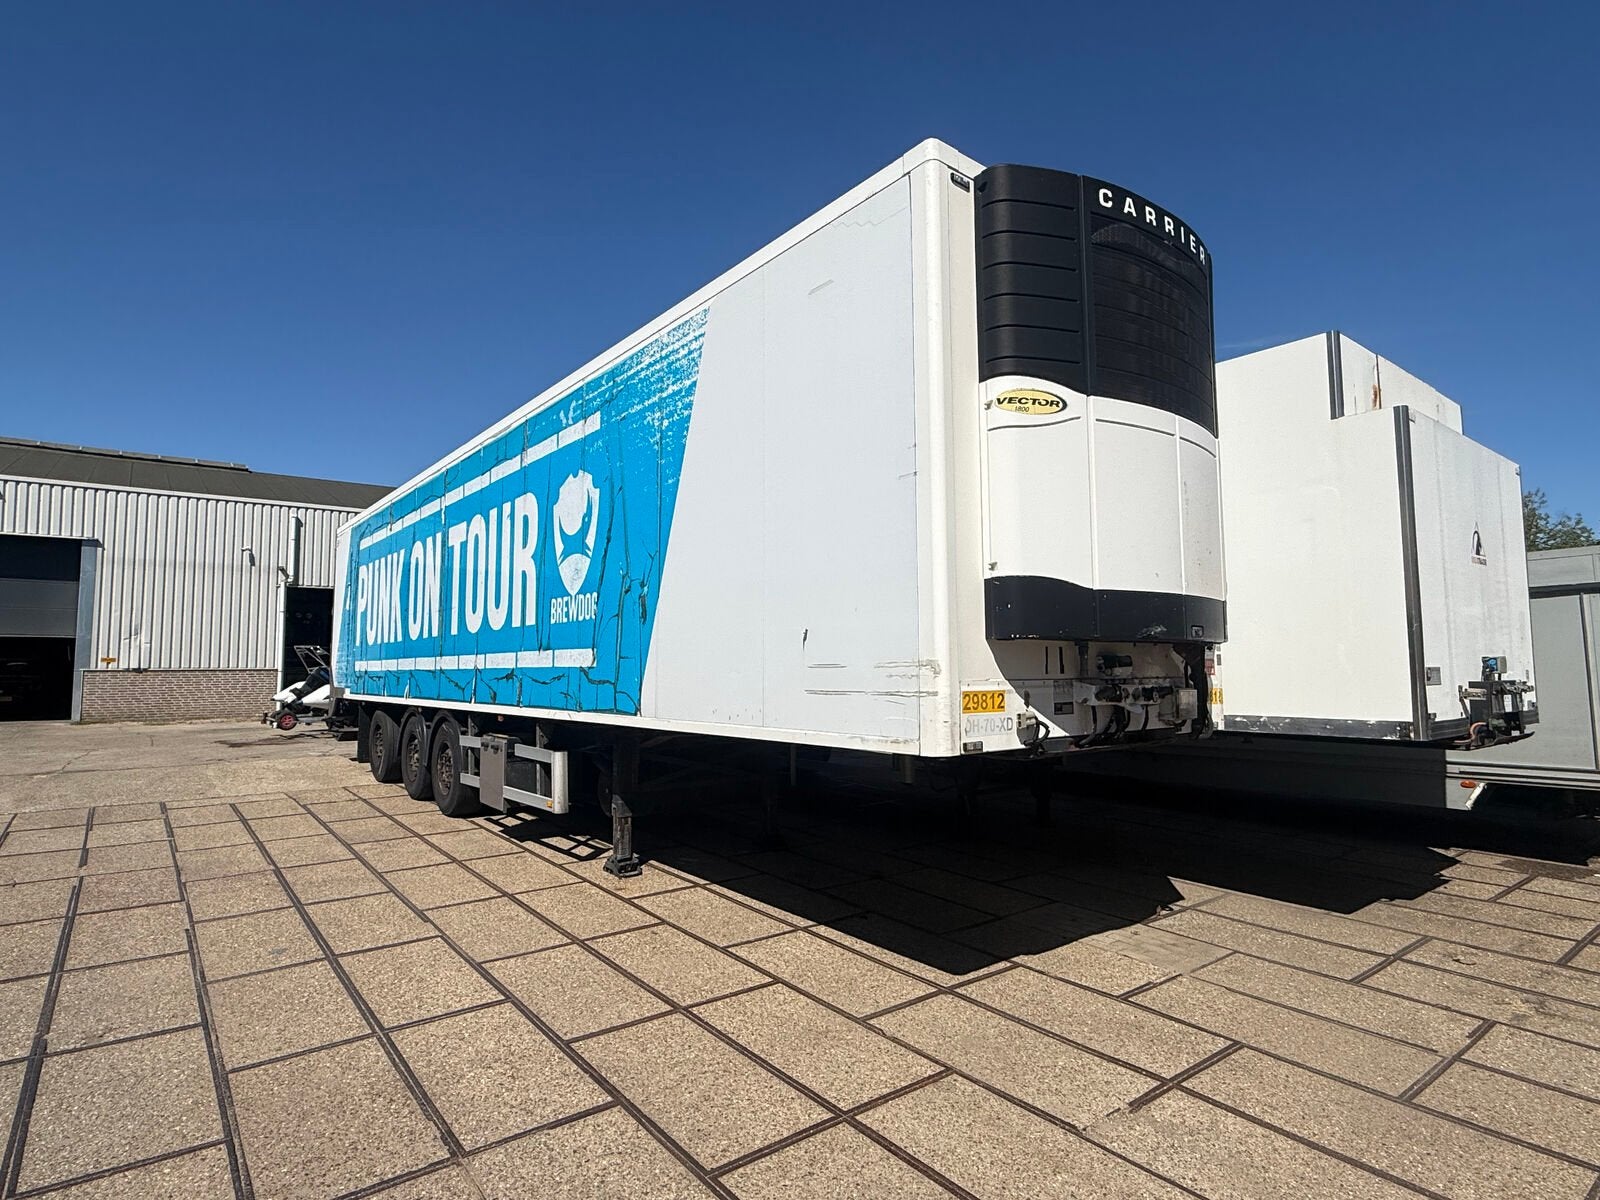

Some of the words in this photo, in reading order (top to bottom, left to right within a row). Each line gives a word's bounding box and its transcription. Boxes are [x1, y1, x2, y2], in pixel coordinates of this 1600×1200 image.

[1098, 188, 1206, 265] CARRIER
[996, 397, 1061, 408] VECTOR
[1014, 405, 1030, 413] 1800
[355, 549, 405, 646] PUNK
[408, 532, 442, 641] ON
[448, 492, 539, 635] TOUR
[550, 592, 598, 624] BREWDOG
[963, 692, 1005, 711] 29812
